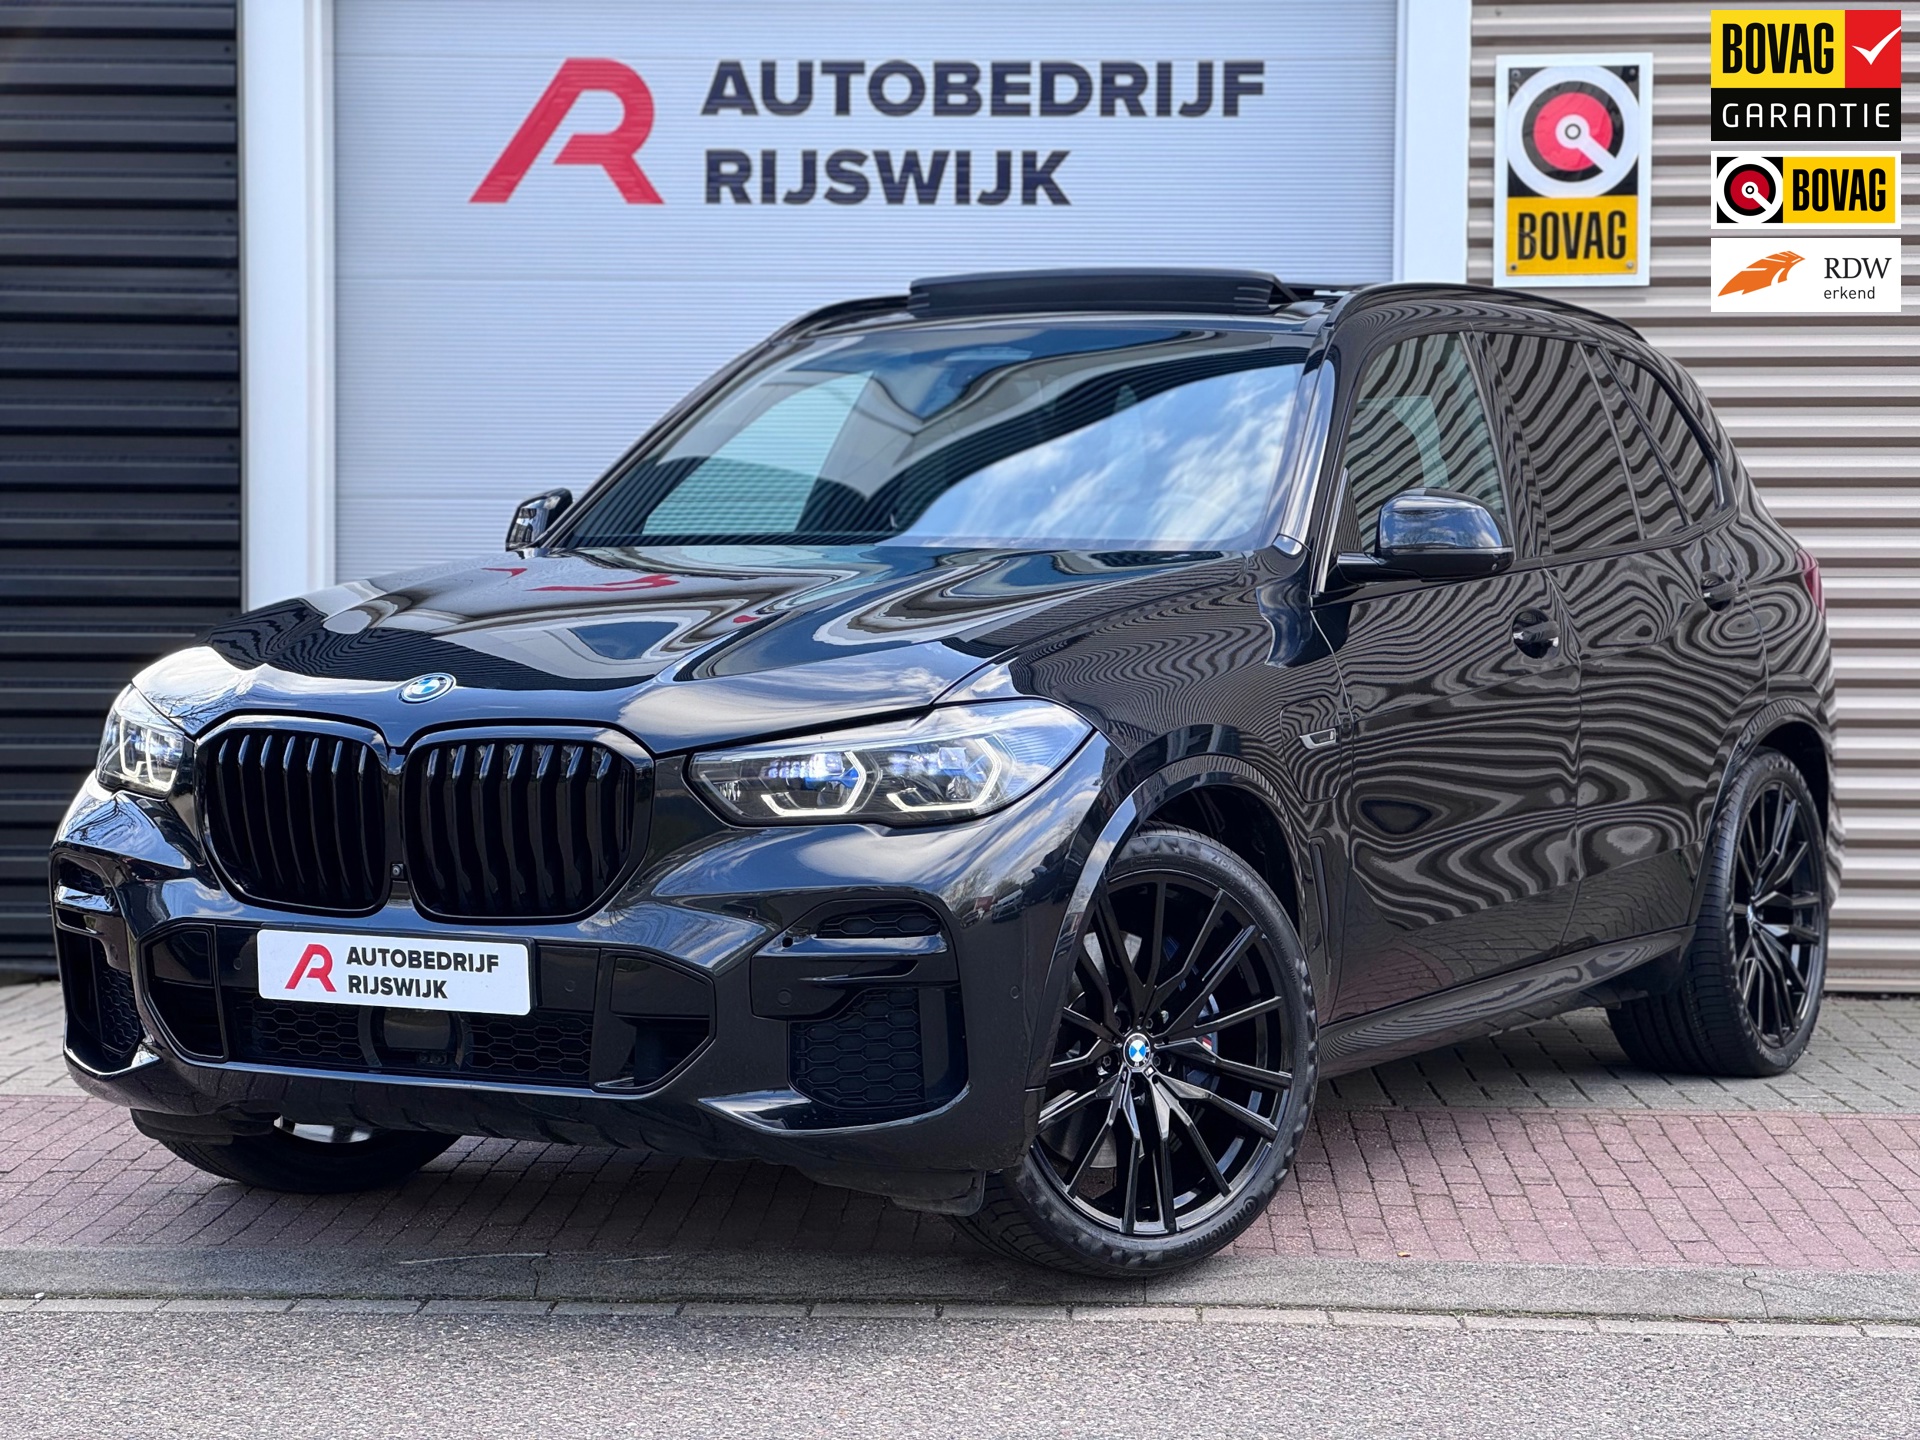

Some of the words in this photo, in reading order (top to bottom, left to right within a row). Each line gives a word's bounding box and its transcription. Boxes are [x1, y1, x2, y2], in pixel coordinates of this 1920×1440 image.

[700, 60, 1265, 118] AUTOBEDRIJF
[705, 150, 1072, 206] RIJSWIJK
[1517, 210, 1626, 261] BOVAG
[346, 946, 500, 974] AUTOBEDRIJF
[347, 974, 448, 999] RIJSWIJK
